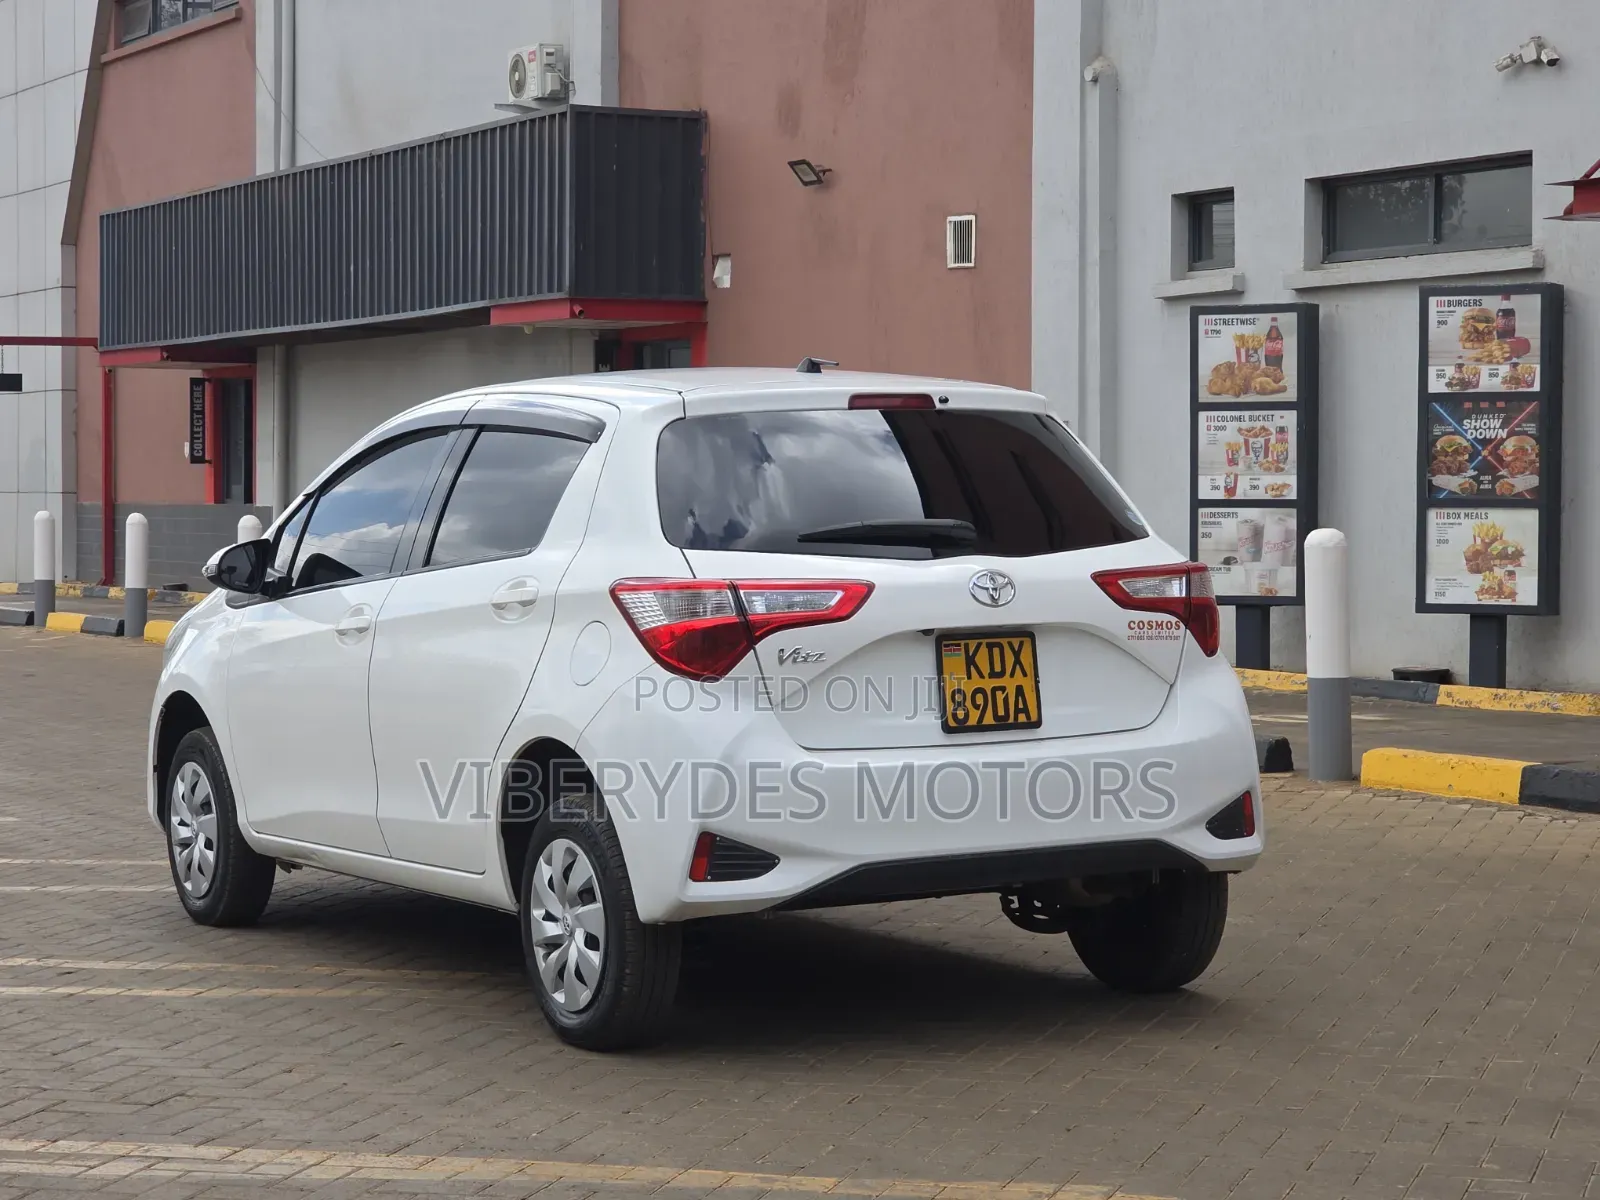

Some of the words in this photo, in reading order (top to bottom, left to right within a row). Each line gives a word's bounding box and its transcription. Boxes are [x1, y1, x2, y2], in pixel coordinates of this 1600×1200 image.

[1447, 299, 1483, 307] BURGERS
[1214, 317, 1257, 326] STREETWISE
[194, 385, 203, 411] HERE
[1216, 415, 1246, 423] COLONEL
[1248, 414, 1275, 422] BUCKET
[1462, 419, 1503, 429] SHOW
[194, 413, 203, 457] COLLECT
[1466, 428, 1508, 439] DOWN
[1446, 511, 1462, 520] BOX
[1463, 511, 1489, 520] MEALS
[1127, 620, 1181, 631] COSMOS
[778, 645, 827, 667] Vitz
[963, 640, 1028, 680] KDX
[950, 684, 1032, 726] 890A
